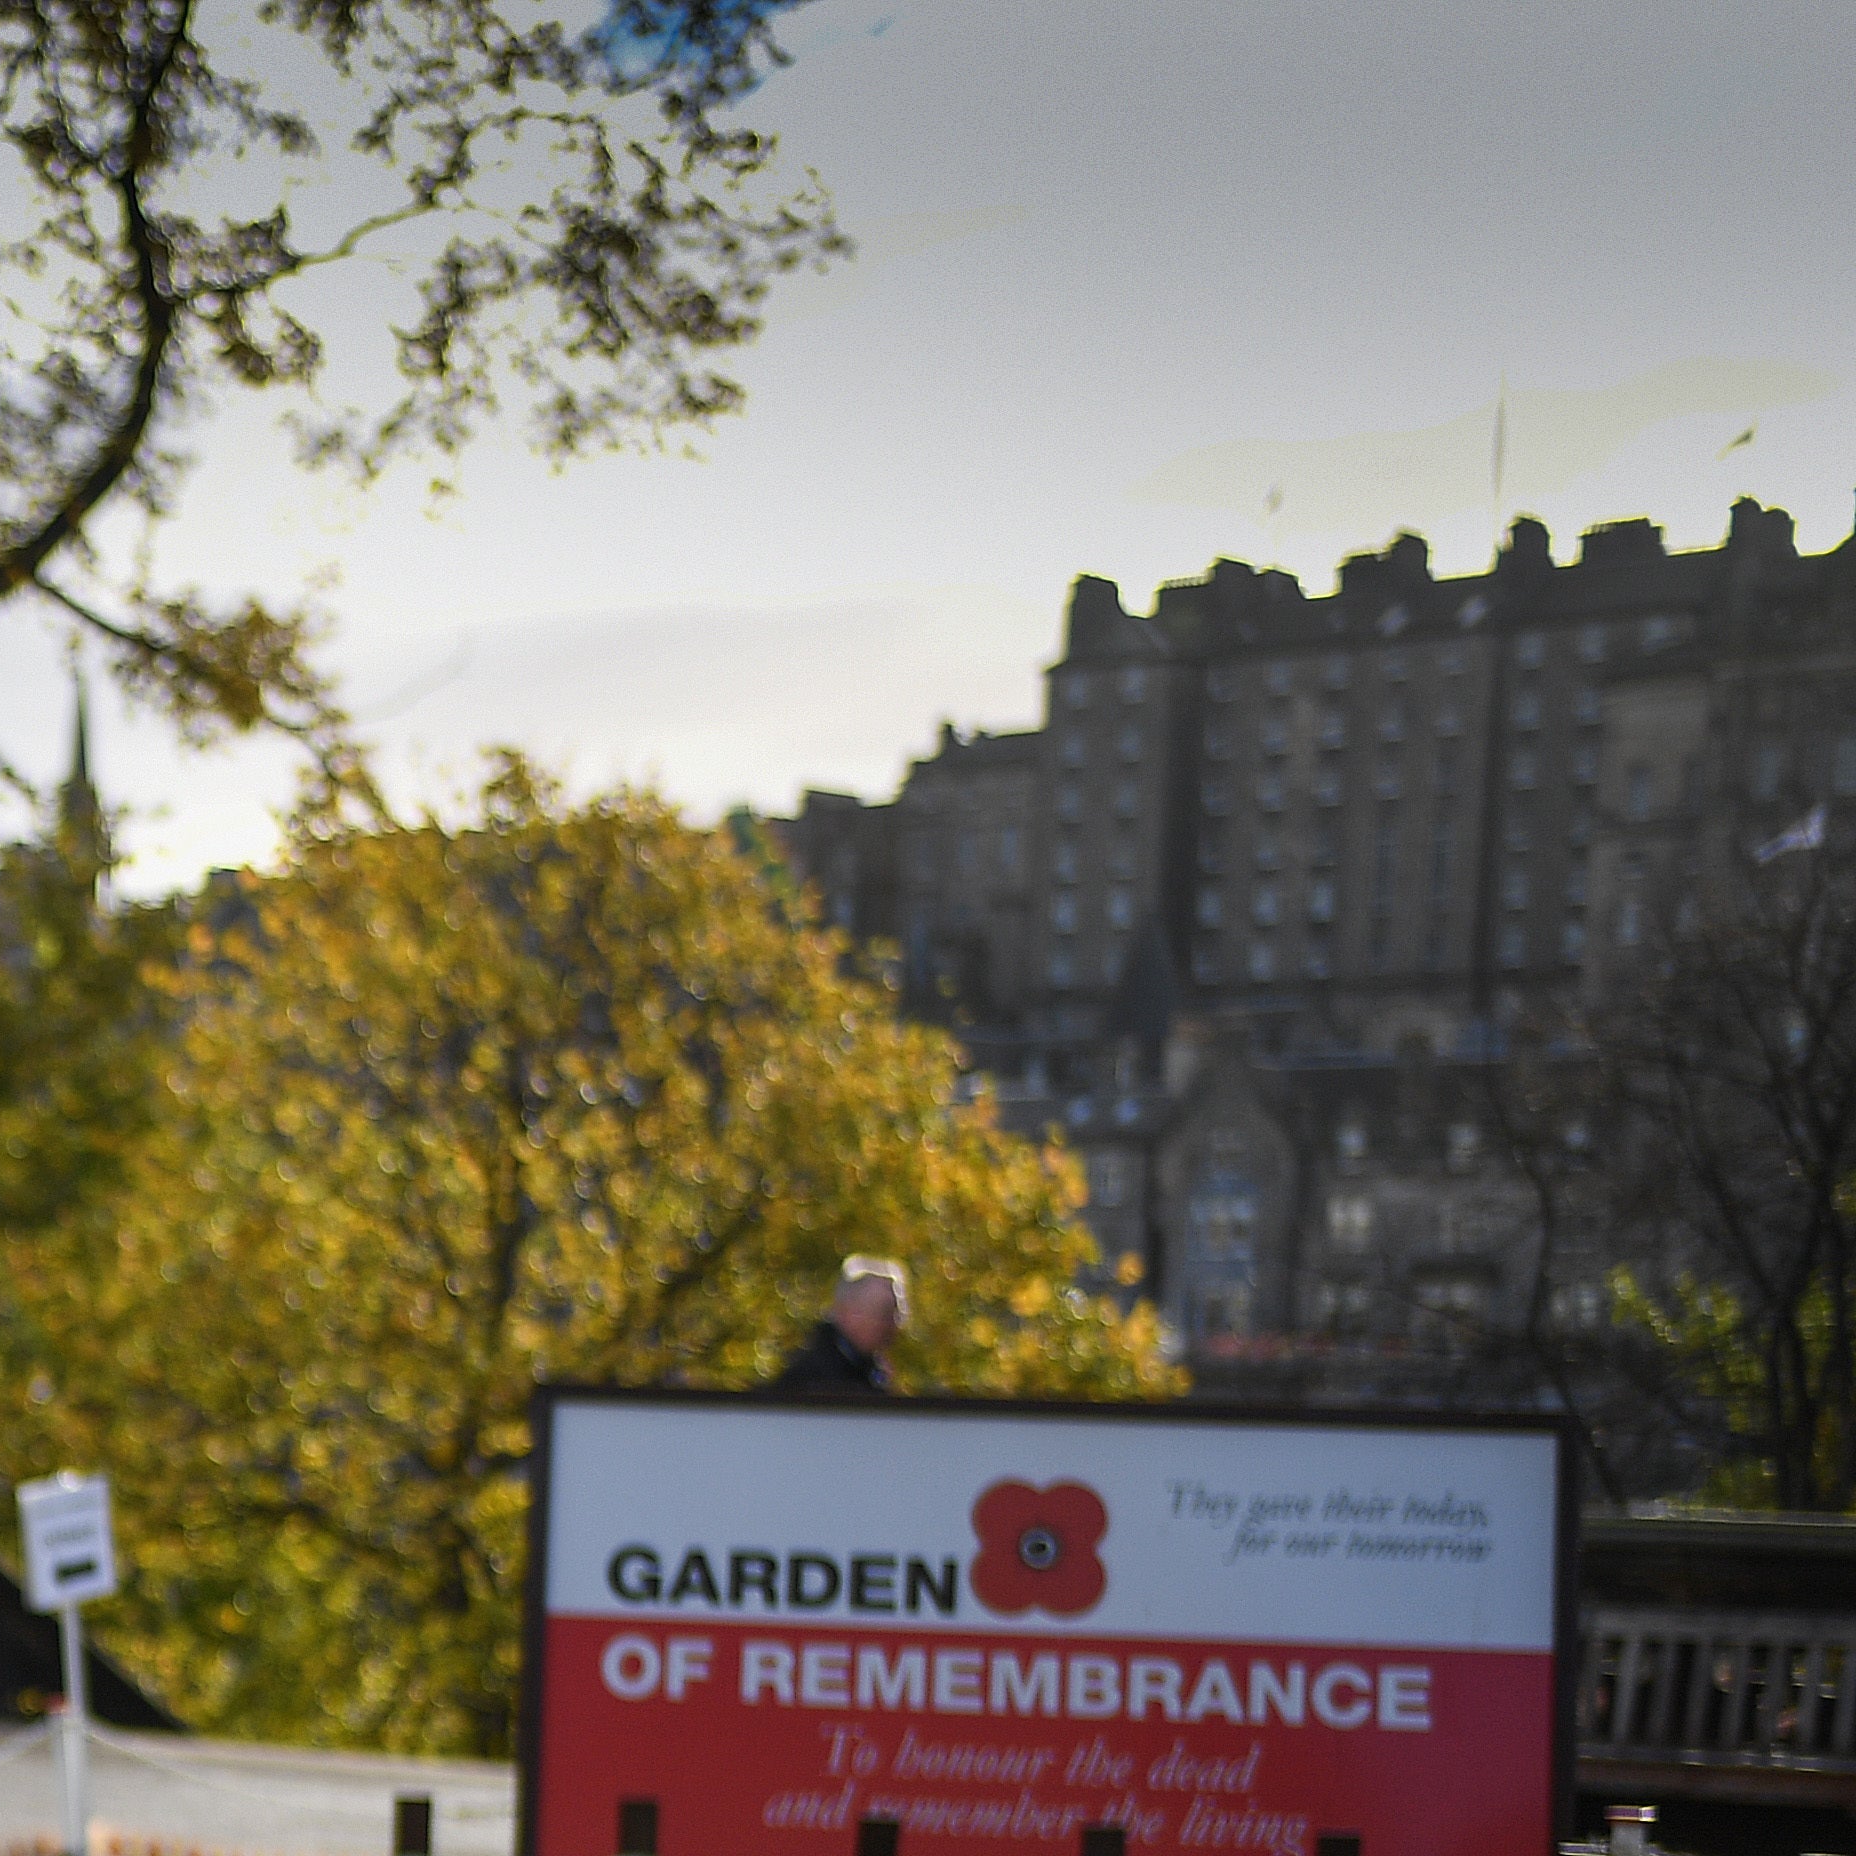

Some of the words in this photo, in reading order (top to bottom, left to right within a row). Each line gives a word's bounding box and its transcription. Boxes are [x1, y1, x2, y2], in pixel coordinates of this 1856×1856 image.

[1164, 1477, 1238, 1531] They
[1243, 1492, 1314, 1528] gave
[1321, 1484, 1396, 1523] their
[1221, 1519, 1279, 1568] for
[1284, 1530, 1339, 1559] our
[1344, 1526, 1494, 1563] tomorrow
[605, 1543, 960, 1616] GARDEN
[599, 1632, 717, 1704] OF
[739, 1639, 1434, 1733] REMEMBRANCE
[820, 1721, 879, 1779] To
[891, 1725, 1057, 1785] honour
[1064, 1733, 1134, 1789] the
[1146, 1737, 1263, 1794] dead
[762, 1777, 858, 1831] and
[1100, 1792, 1166, 1845] the
